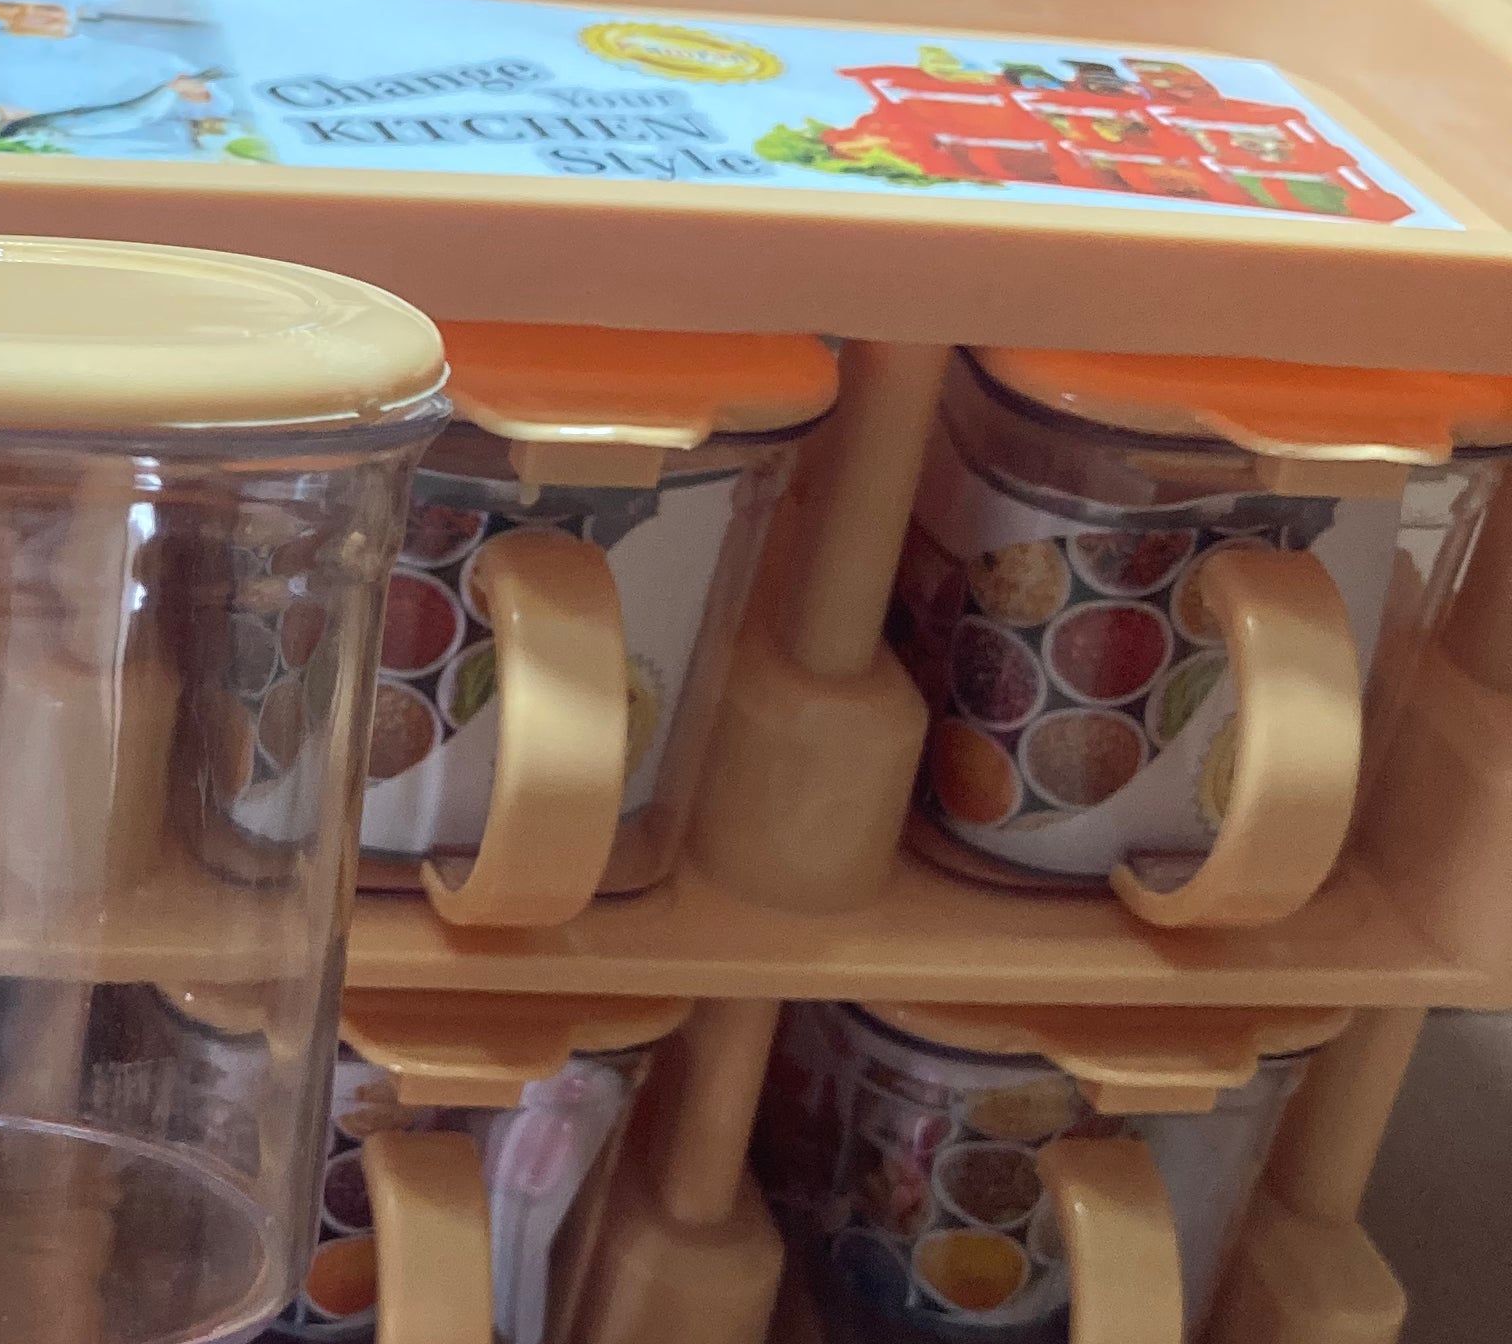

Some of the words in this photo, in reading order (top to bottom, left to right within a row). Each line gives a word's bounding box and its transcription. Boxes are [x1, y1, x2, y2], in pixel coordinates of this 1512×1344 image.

[266, 62, 543, 109] Change
[302, 113, 714, 144] KITCHEN
[548, 146, 766, 182] Style
